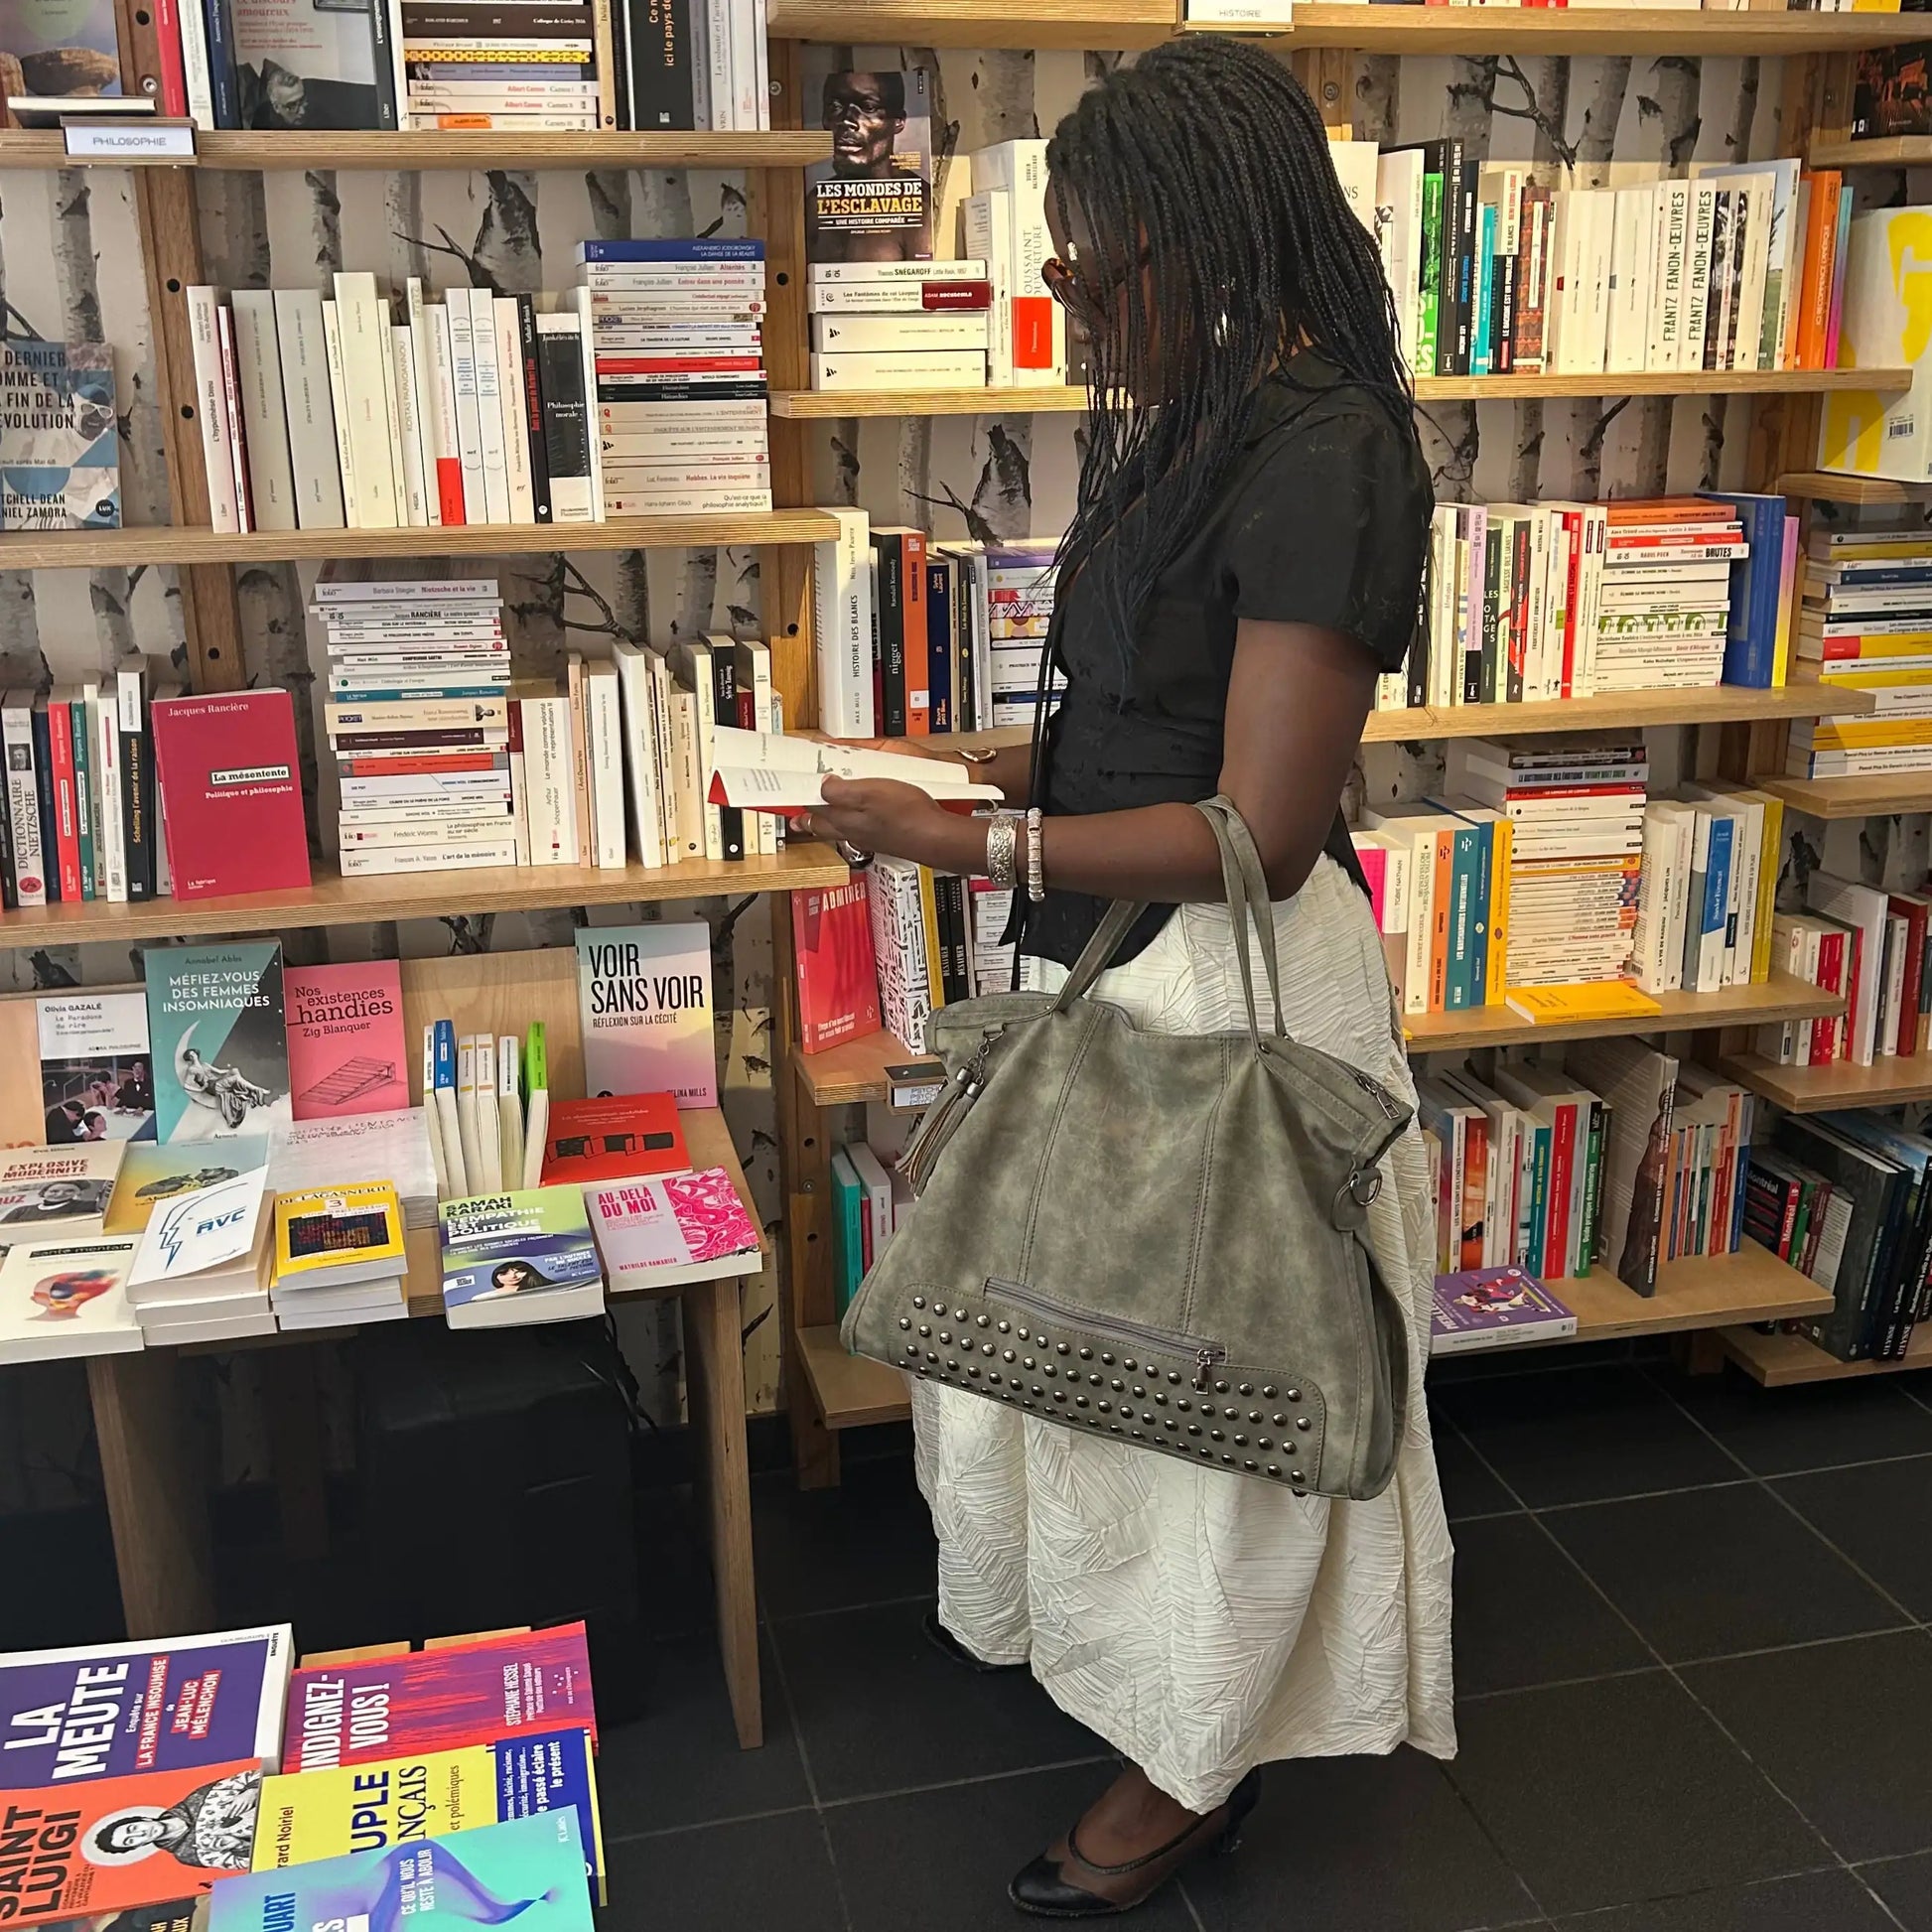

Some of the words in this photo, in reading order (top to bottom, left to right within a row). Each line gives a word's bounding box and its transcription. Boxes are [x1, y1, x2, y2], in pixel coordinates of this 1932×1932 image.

[649, 9, 659, 23] Ce
[1219, 9, 1262, 18] HISTOIRE
[663, 13, 675, 38] pays
[663, 41, 674, 52] le
[664, 54, 675, 66] ici
[92, 136, 167, 147] PHILOSOPHIE
[817, 184, 842, 198] LES
[844, 183, 901, 197] MONDES
[904, 182, 922, 195] DE
[817, 198, 922, 214] L'ESCLAVAGE
[1663, 297, 1678, 342] FRANTZ
[1688, 296, 1704, 341] FRANTZ
[6, 350, 67, 366] DERNIER
[44, 371, 59, 386] ET
[7, 392, 29, 408] FIN
[36, 392, 53, 408] DE
[59, 392, 74, 408] LA
[207, 399, 220, 442] L'hypothèse
[40, 493, 66, 504] DEAN
[27, 507, 67, 518] ZAMORA
[1706, 548, 1731, 558] BRUTES
[1483, 590, 1498, 599] LES
[411, 610, 442, 619] RANCIÈRE
[890, 643, 901, 674] nigger
[168, 706, 206, 717] Jacques
[207, 702, 249, 713] Rancière
[548, 707, 557, 752] représentation
[131, 770, 139, 780] de
[213, 772, 226, 782] La
[228, 769, 287, 780] mésentente
[131, 781, 140, 808] l'avenir
[205, 790, 239, 799] Politique
[249, 784, 294, 795] philosophie
[11, 778, 29, 869] DICTIONNAIRE
[24, 790, 40, 857] NIETZSCHE
[132, 809, 141, 843] Schelling
[822, 882, 866, 911] ADMIRER
[185, 956, 218, 965] Annabel
[588, 942, 640, 979] VOIR
[169, 970, 260, 986] MÉFIEZ-VOUS
[172, 988, 198, 999] DES
[204, 984, 259, 997] FEMMES
[295, 986, 322, 998] Nos
[307, 987, 385, 1008] existences
[592, 978, 648, 1014] SANS
[652, 976, 705, 1010] VOIR
[69, 1002, 102, 1011] GAZALÉ
[163, 995, 270, 1013] INSOMNIAQUES
[299, 999, 393, 1025] handies
[302, 1027, 322, 1037] Zig
[324, 1021, 371, 1035] Blanquer
[593, 1015, 629, 1029] RÉFLEXION
[630, 1015, 644, 1027] SUR
[645, 1014, 654, 1026] LA
[656, 1013, 677, 1025] CÉCITÉ
[8, 1159, 88, 1172] EXPLOSIVE
[1586, 1164, 1597, 1192] mentoring
[329, 1199, 343, 1208] 3
[446, 1196, 511, 1211] SAMAH
[598, 1186, 651, 1205] AU-DELÀ
[446, 1206, 544, 1226] L'EMPATHIE
[447, 1202, 512, 1217] KARAKI
[601, 1202, 622, 1218] DU
[627, 1197, 657, 1213] MOI
[1585, 1200, 1593, 1226] pratique
[197, 1208, 246, 1234] AVC
[447, 1222, 469, 1232] EST
[447, 1218, 540, 1238] POLITIQUE
[1782, 1204, 1796, 1242] Montréal
[1582, 1227, 1590, 1243] Guide
[30, 1247, 71, 1258] Santé
[74, 1244, 132, 1254] mentale
[619, 1261, 645, 1271] MATHILDE
[648, 1257, 678, 1268] RAMADIER
[1882, 1323, 1896, 1355] ULYSSE
[1896, 1323, 1912, 1354] ULYSSE
[269, 1632, 279, 1657] ENQUÊTE
[146, 1659, 167, 1709] INSOUMISE
[502, 1662, 519, 1689] HESSEL
[125, 1705, 141, 1733] Enquête
[134, 1693, 144, 1704] sur
[175, 1681, 199, 1730] JEAN-LUC
[192, 1674, 218, 1734] MÉLENCHON
[503, 1689, 522, 1726] STÉPHANE
[4, 1703, 67, 1749] LA
[52, 1663, 130, 1779] MEUTE
[140, 1711, 159, 1749] FRANCE
[300, 1675, 345, 1773] INDIGNEZ-
[138, 1750, 153, 1766] LA
[502, 1748, 513, 1774] racisme,
[531, 1743, 546, 1775] éclaire
[549, 1741, 565, 1776] présent
[445, 1765, 465, 1818] polémiques
[503, 1774, 514, 1796] laïcité,
[533, 1777, 549, 1804] passé
[550, 1778, 563, 1788] le
[276, 1806, 294, 1842] Noiriel
[450, 1821, 460, 1831] et
[0, 1806, 43, 1920] SAINT
[19, 1810, 81, 1916] LUIGI
[399, 1859, 415, 1879] NOUS
[417, 1849, 434, 1876] ABOLIR
[400, 1880, 415, 1902] QU'IL
[416, 1877, 434, 1886] À
[402, 1903, 416, 1915] CE
[419, 1885, 435, 1912] RESTE
